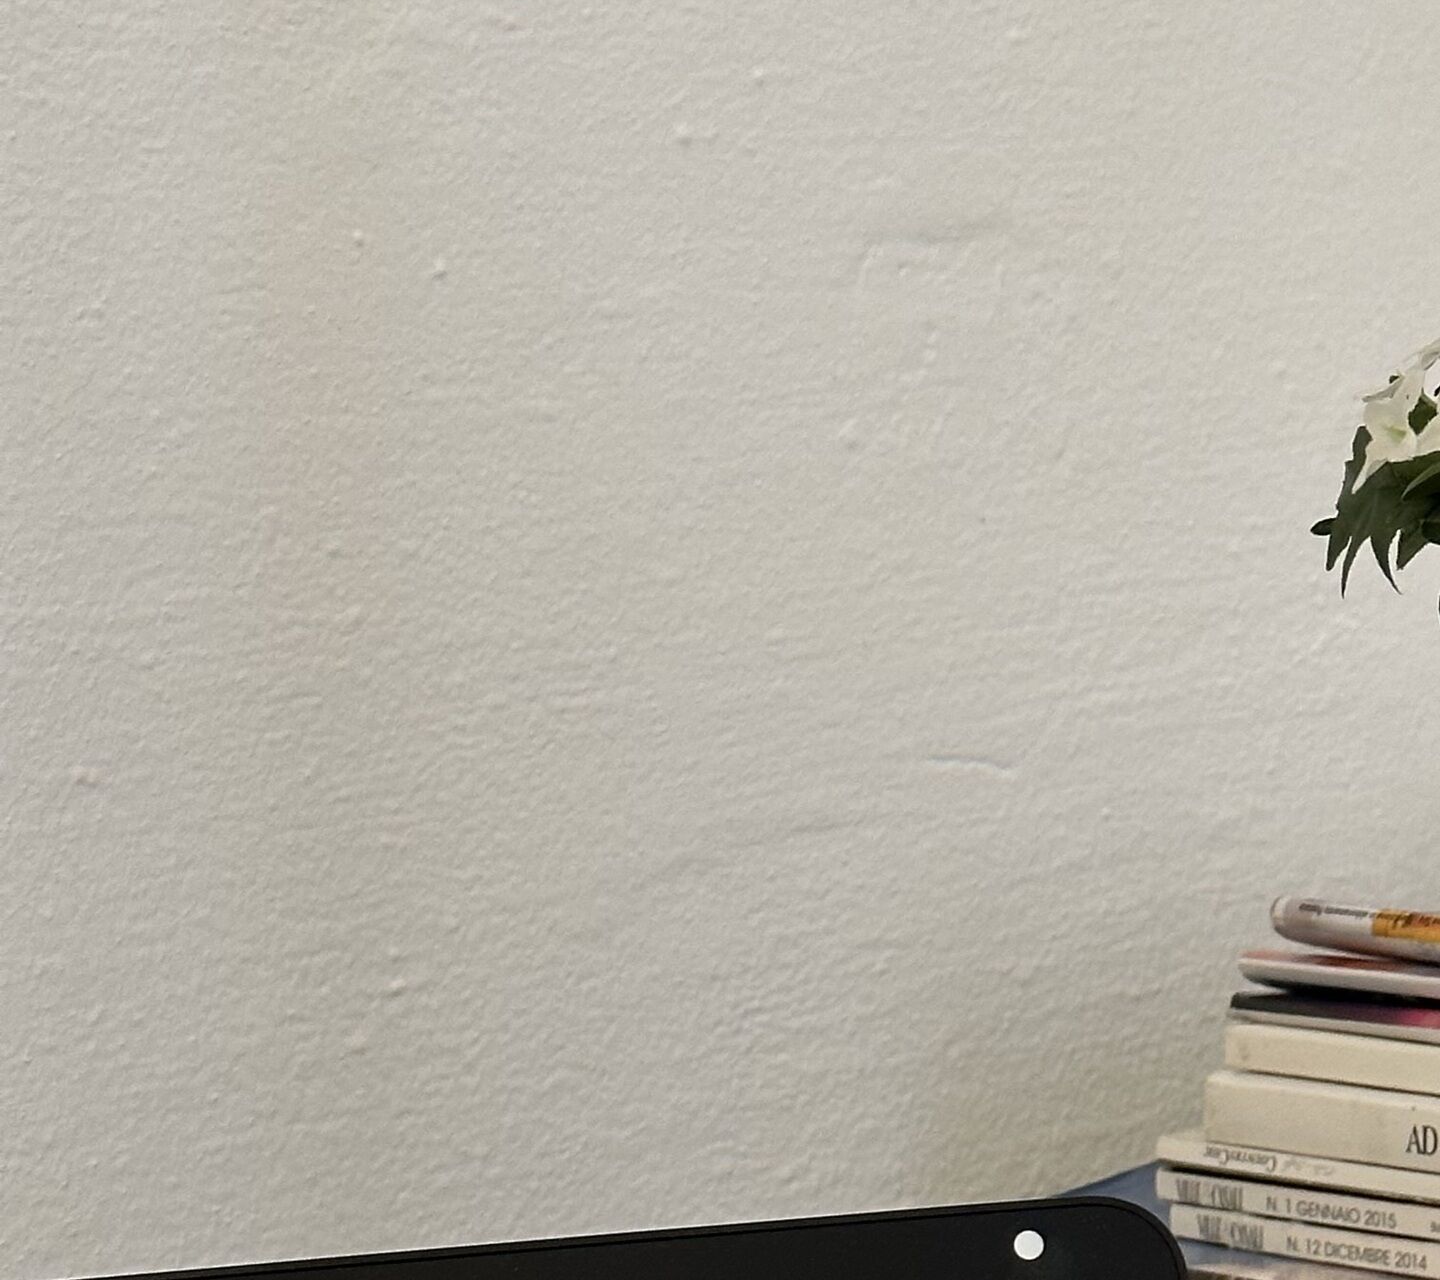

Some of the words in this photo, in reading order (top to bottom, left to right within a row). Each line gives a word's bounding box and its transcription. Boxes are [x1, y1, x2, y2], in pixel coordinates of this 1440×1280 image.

[1405, 1124, 1438, 1156] AD
[1363, 1210, 1397, 1229] 2015
[1324, 1241, 1391, 1266] DICEMBRE
[1393, 1251, 1427, 1271] 2014
